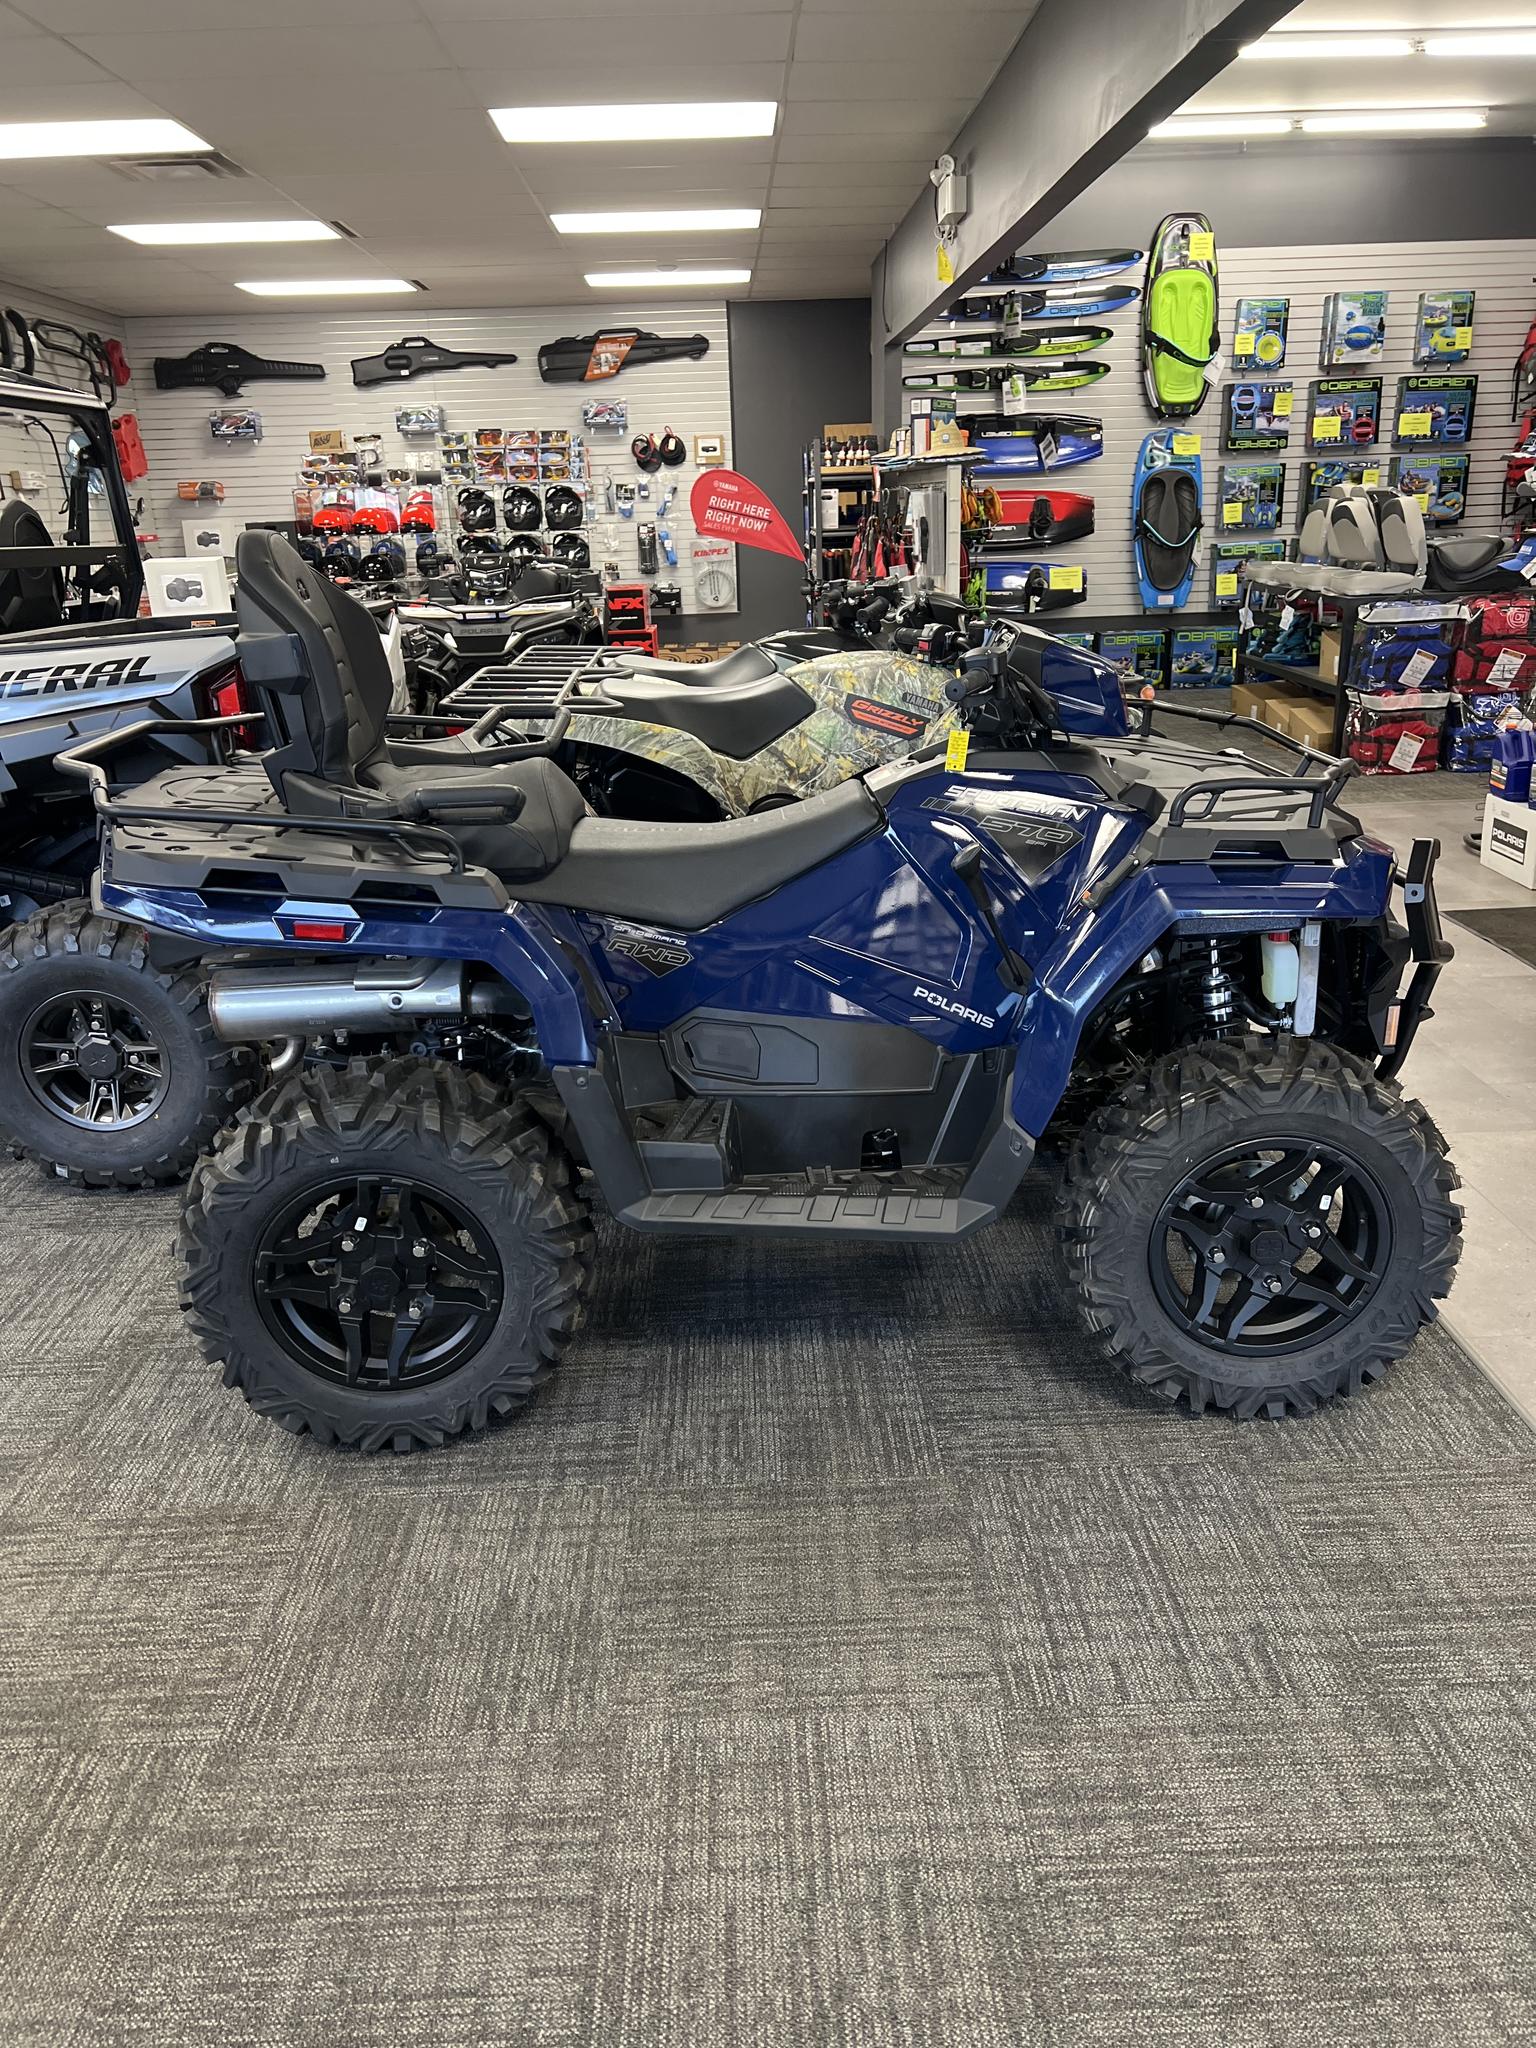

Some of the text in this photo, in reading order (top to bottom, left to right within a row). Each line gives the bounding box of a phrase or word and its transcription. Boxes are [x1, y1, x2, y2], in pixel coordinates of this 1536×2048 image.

[1050, 304, 1100, 315] OBRIEN
[1329, 380, 1380, 390] OBRIEN
[1418, 377, 1475, 387] OBRIEN
[1228, 466, 1283, 477] OBRIEN
[1404, 456, 1468, 468] OBRIEN
[709, 495, 771, 519] RIGHT HERE
[705, 509, 768, 533] RIGHT NOW!
[1221, 543, 1285, 556] OBRIEN
[460, 627, 502, 635] POLARIS
[1103, 633, 1166, 646] OBRIEN
[851, 699, 925, 726] GRIZZLY
[905, 693, 940, 713] YAMAHA
[944, 784, 1091, 823] SPORTSMAN
[977, 815, 1073, 844] 570
[1492, 827, 1526, 850] POLARIS
[605, 938, 692, 967] AWD
[913, 986, 996, 1029] POLARIS
